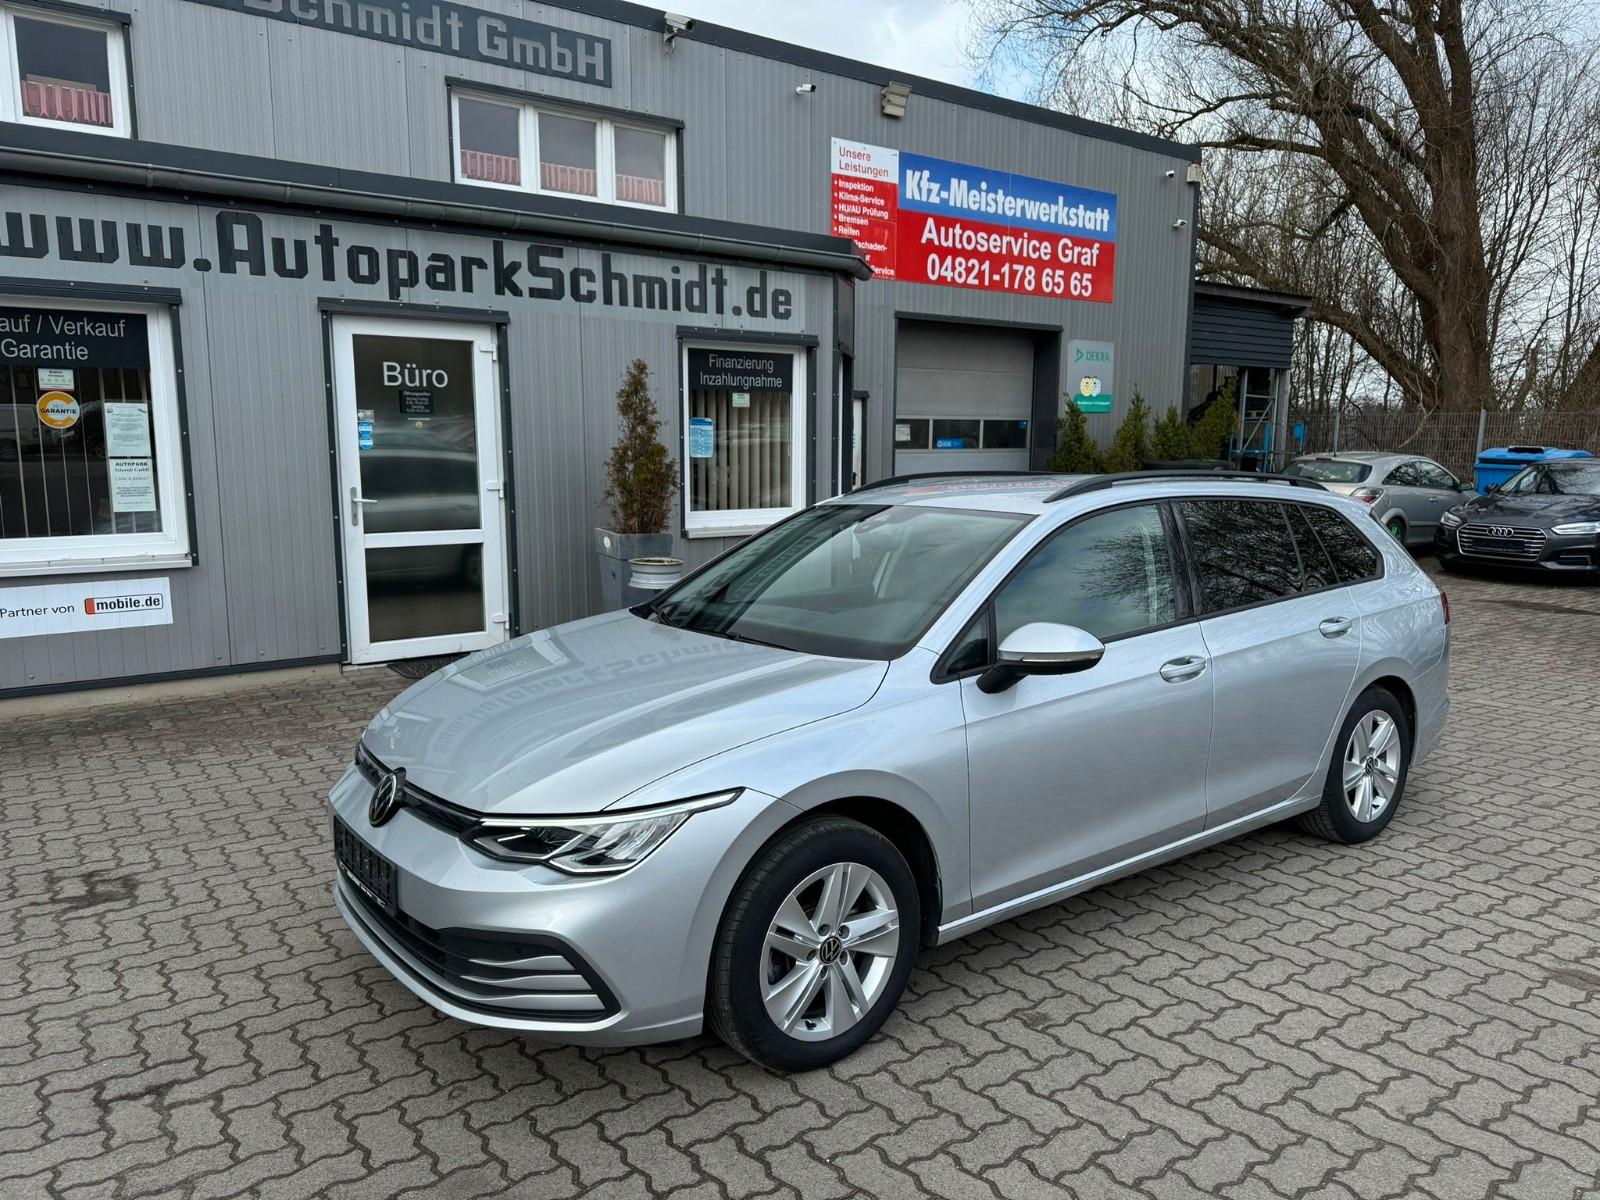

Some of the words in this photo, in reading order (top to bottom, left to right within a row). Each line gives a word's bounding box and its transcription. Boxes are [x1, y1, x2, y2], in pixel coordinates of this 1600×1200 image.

[476, 15, 605, 81] GmbH
[839, 147, 872, 161] Unsere
[839, 160, 889, 178] Leistungen
[838, 179, 874, 193] Inspektion
[838, 191, 885, 207] Klima-Service
[905, 168, 1110, 233] Kfz-Meisterwerkstatt
[838, 204, 861, 215] HU/AU
[862, 205, 889, 220] Prüfung
[838, 213, 869, 226] Bremsen
[838, 225, 860, 237] Reifen
[920, 217, 1052, 261] Autoservice
[1057, 238, 1100, 267] Graf
[0, 210, 793, 321] www.AutoparkSchmidt.de
[926, 253, 1036, 291] 04821-178
[1041, 268, 1065, 295] 65
[1070, 271, 1093, 297] 65
[36, 315, 43, 334] /
[49, 315, 126, 338] Verkauf
[0, 338, 89, 361] Garantie
[1086, 351, 1111, 361] DEKRA
[708, 354, 774, 373] Finanzierung
[382, 361, 449, 388] Büro
[700, 371, 783, 390] Inzahlungnahme
[0, 607, 48, 618] Partner
[51, 604, 75, 614] von
[96, 596, 161, 611] mobile.de
